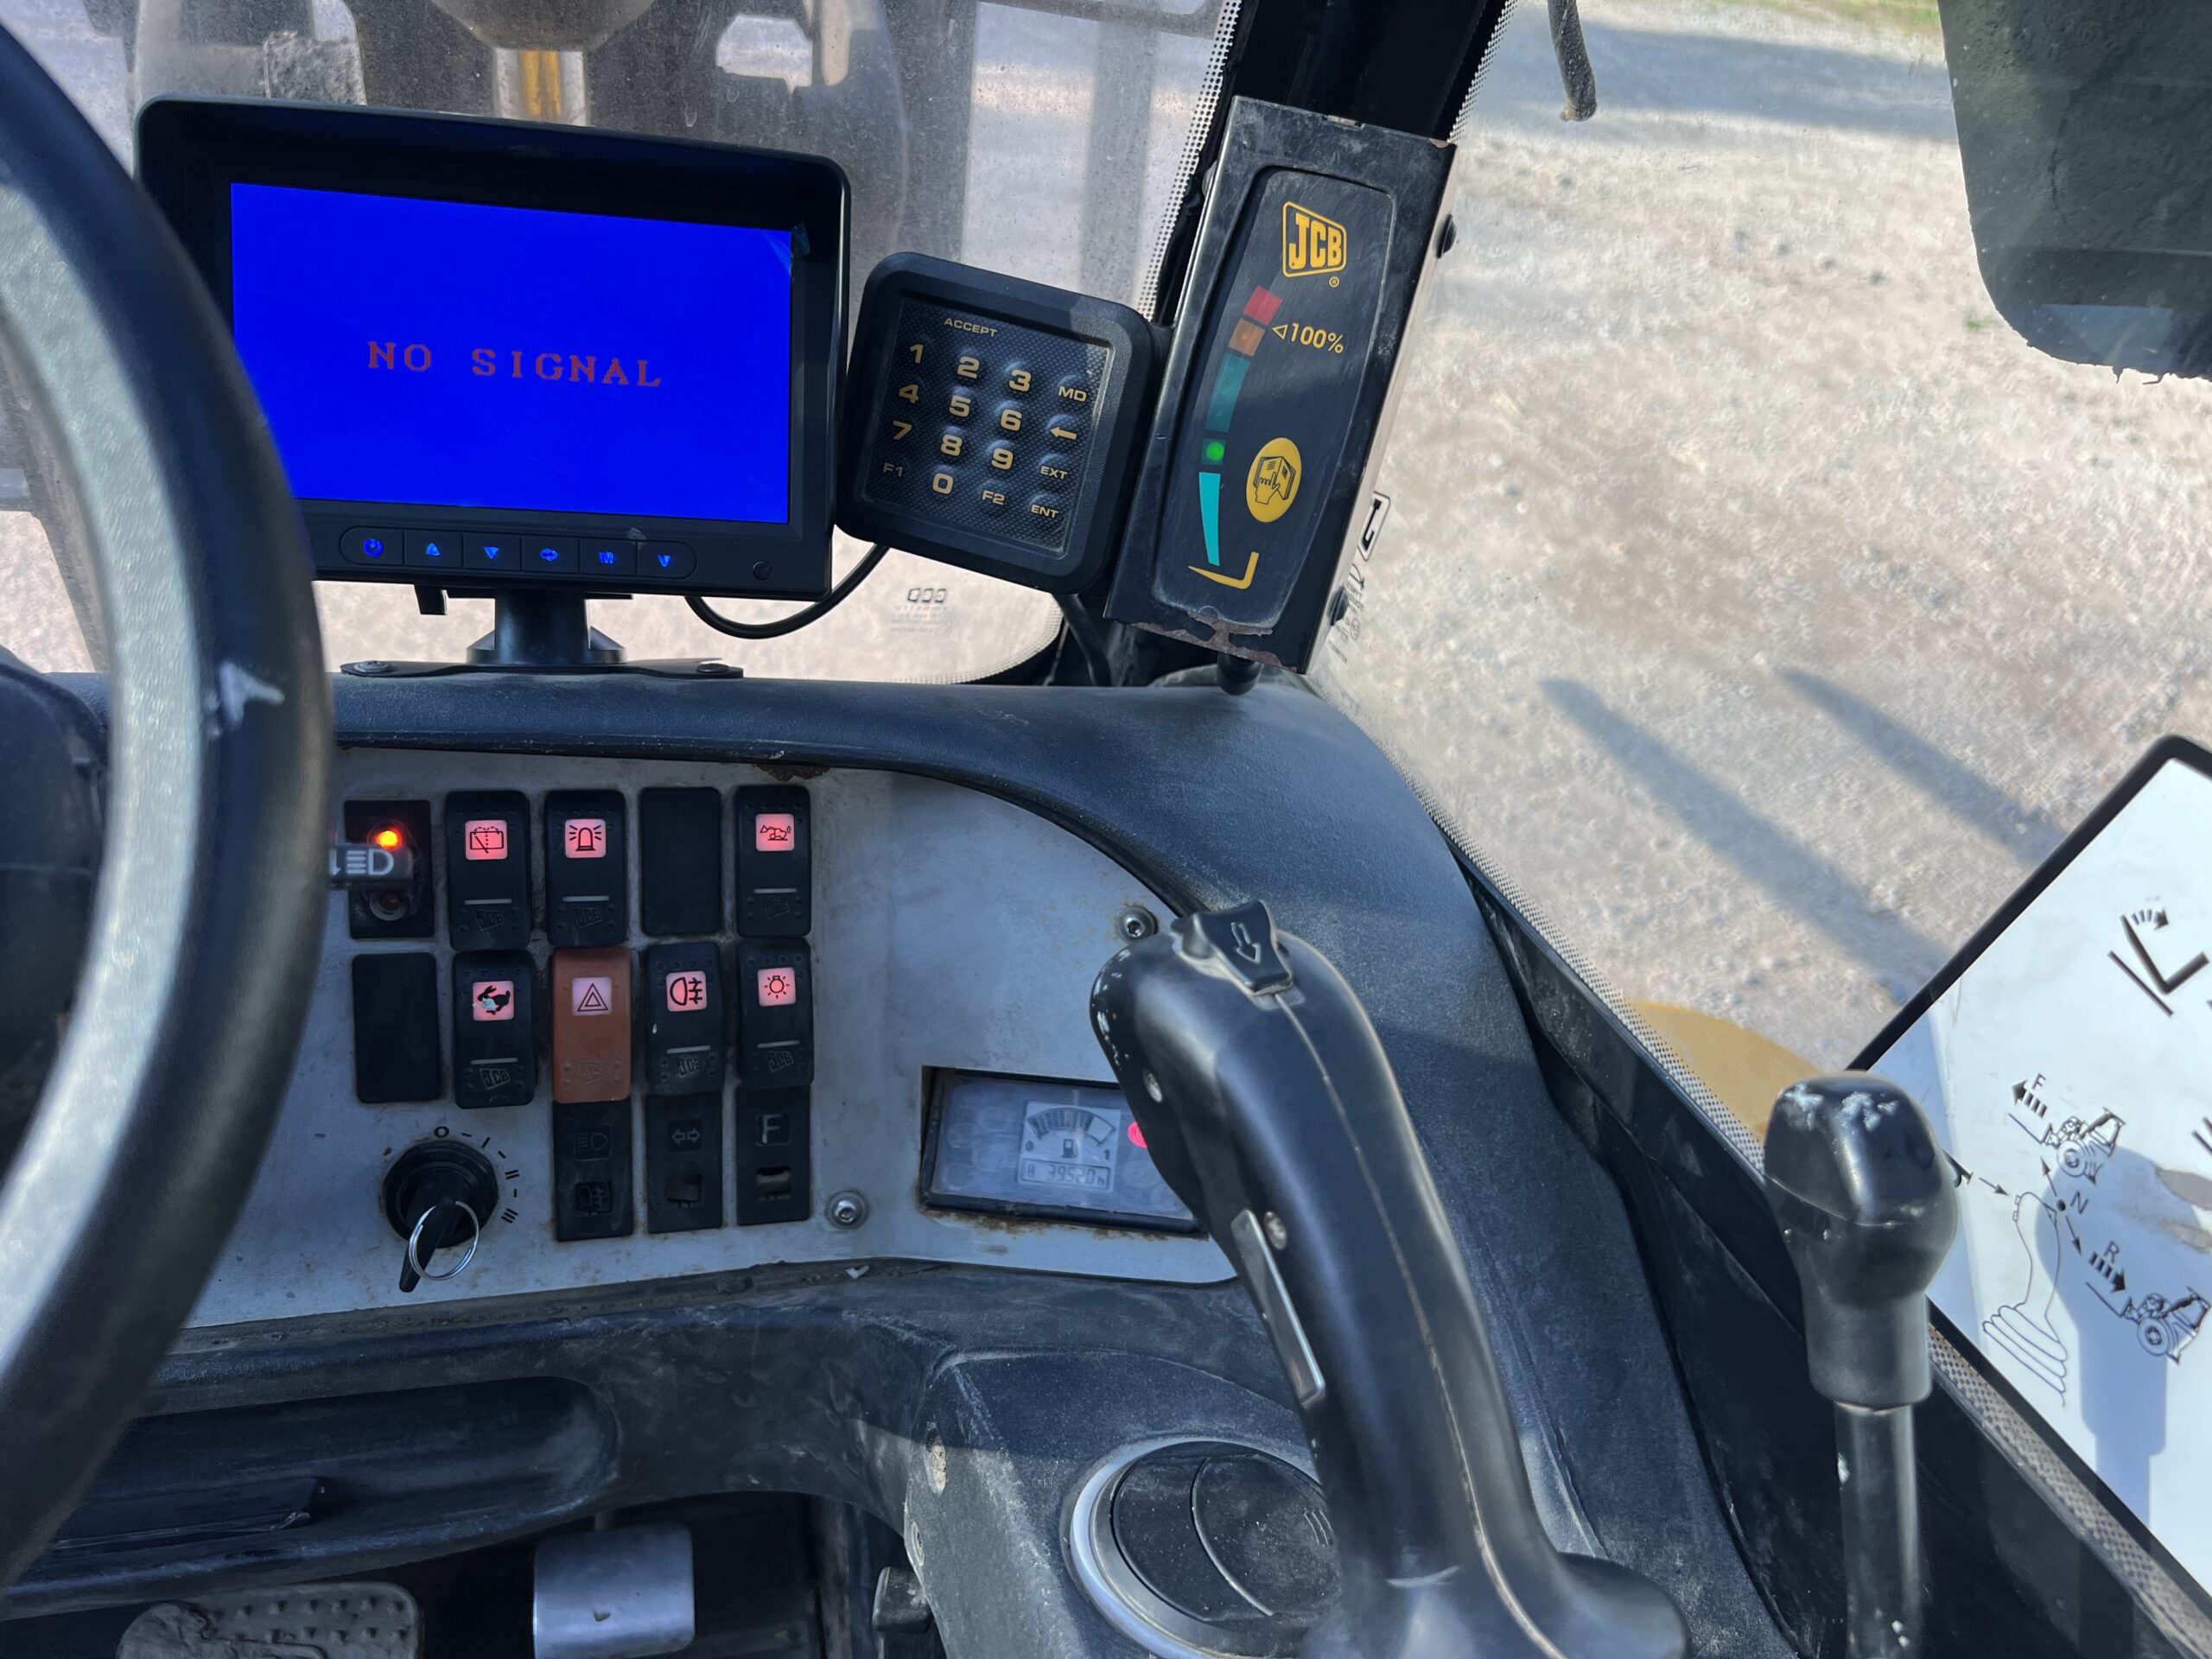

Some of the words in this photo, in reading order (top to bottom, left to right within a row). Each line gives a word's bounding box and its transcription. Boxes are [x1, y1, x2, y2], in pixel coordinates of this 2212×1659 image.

[1287, 212, 1345, 270] JCB
[944, 317, 998, 337] ACCEPT
[1289, 322, 1344, 354] 100%
[367, 341, 432, 372] NO
[472, 348, 662, 388] SIGNAL
[909, 344, 925, 364] 1
[957, 355, 980, 379] 2
[1008, 369, 1032, 392] 3
[898, 385, 919, 404] 4
[1058, 385, 1087, 403] MD
[949, 395, 971, 418] 5
[892, 420, 912, 441] 7
[1000, 409, 1022, 432] 6
[940, 434, 963, 457] 8
[882, 462, 904, 477] F1
[991, 448, 1014, 471] 9
[1039, 465, 1068, 480] EXT
[932, 473, 954, 495] 0
[982, 490, 1006, 505] F2
[1031, 504, 1059, 518] ENT
[480, 1068, 511, 1090] JCB
[2031, 1072, 2046, 1090] F
[762, 1114, 783, 1143] F
[2069, 1190, 2088, 1215] N
[2103, 1240, 2120, 1263] R
